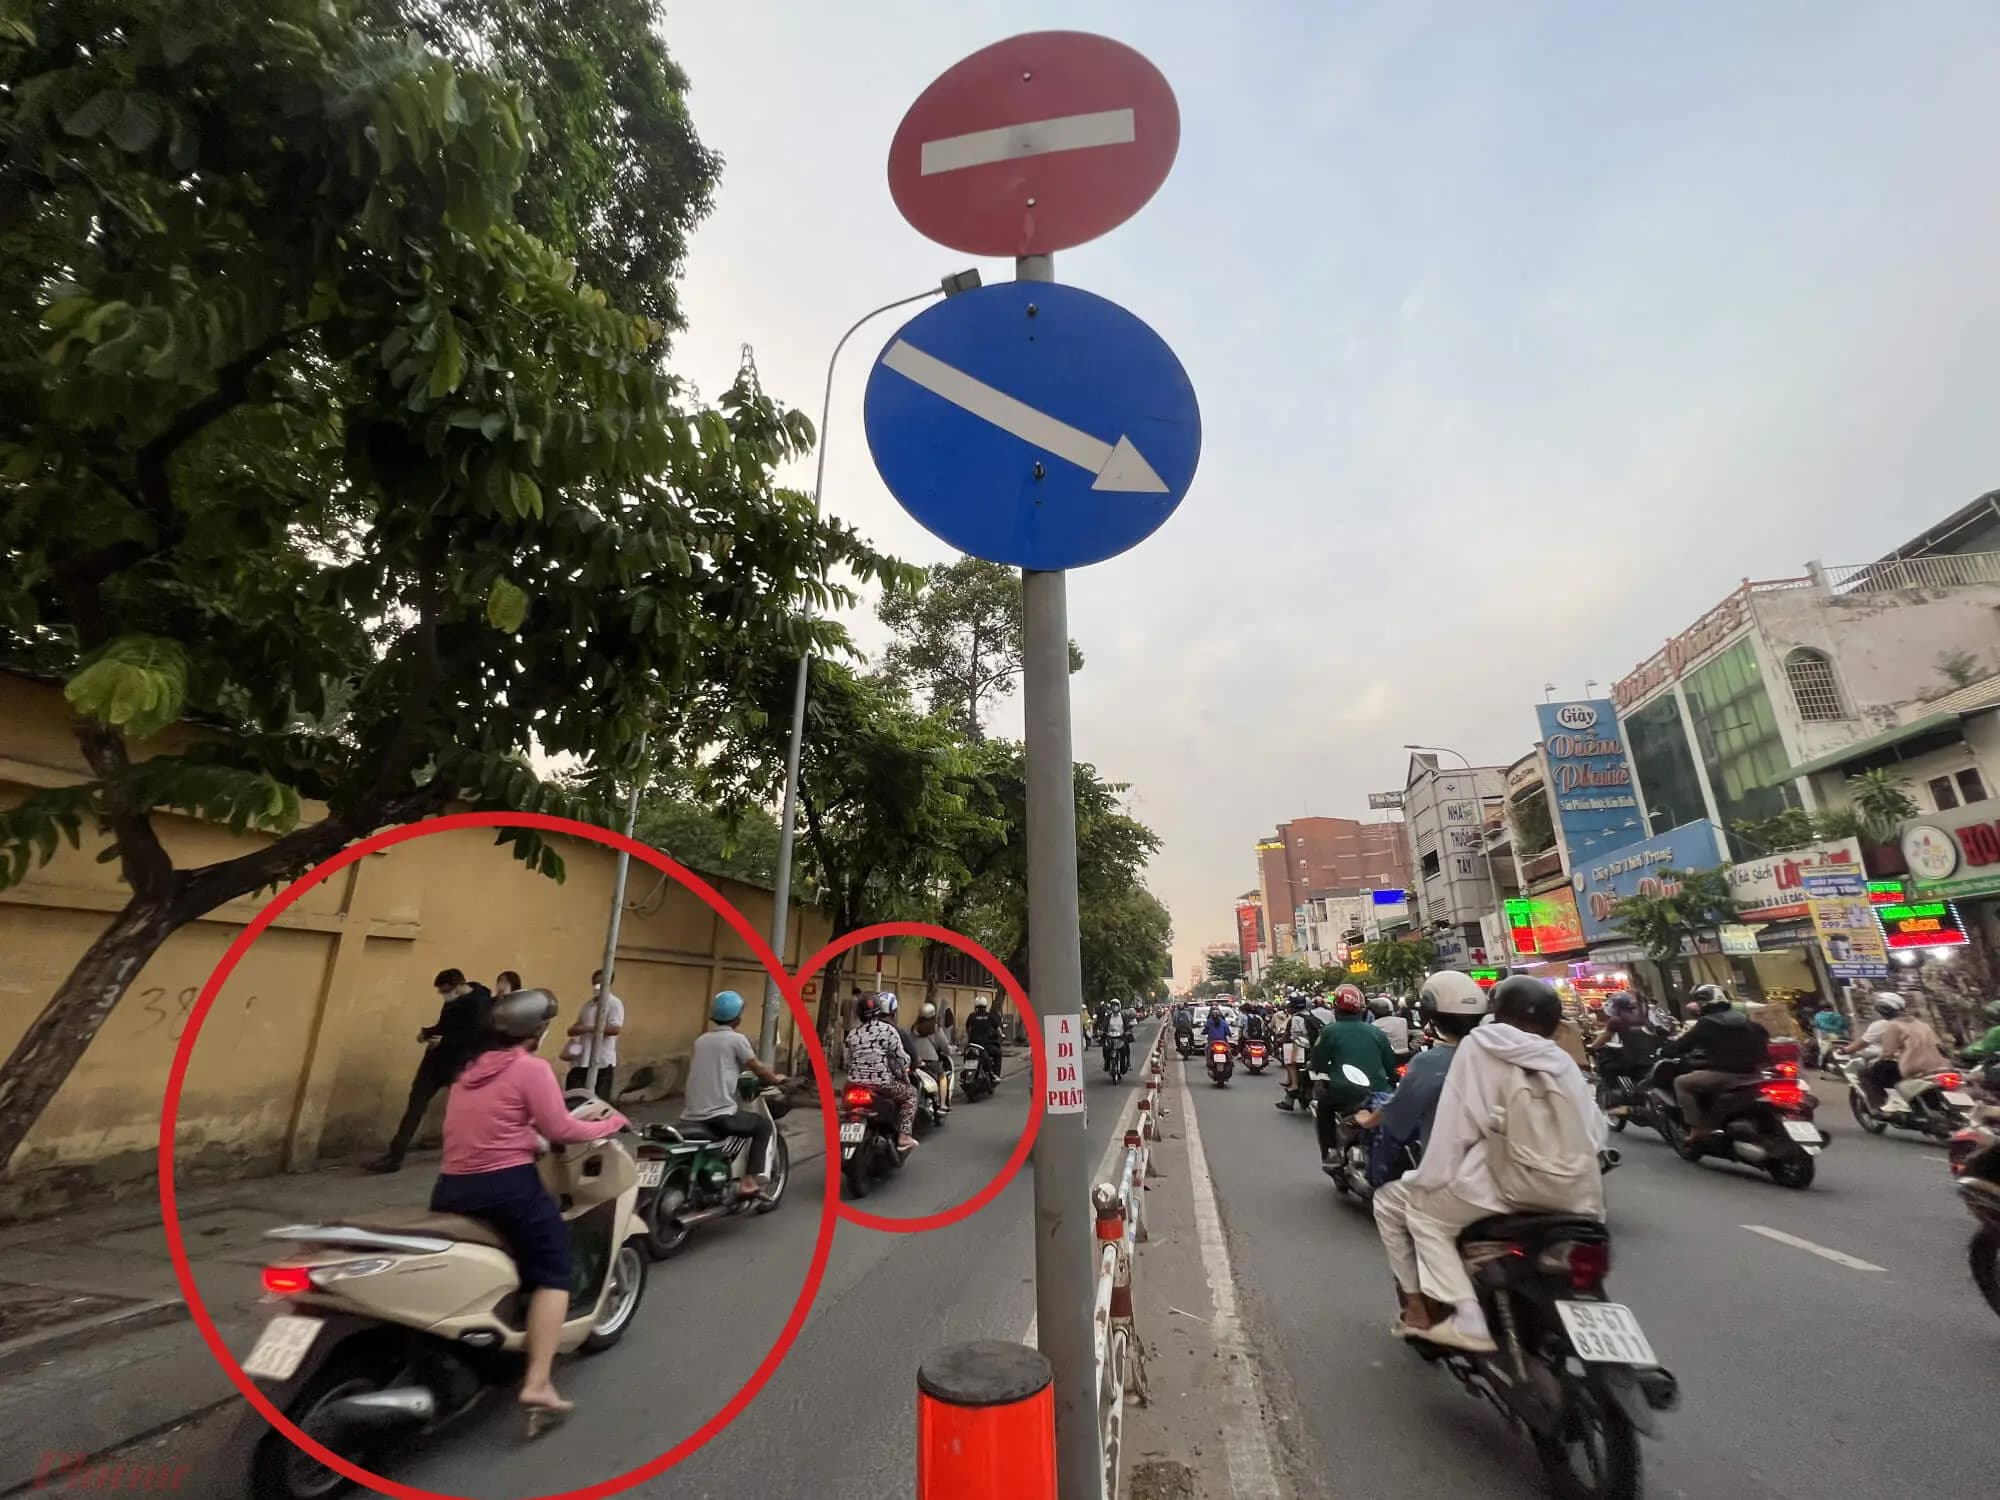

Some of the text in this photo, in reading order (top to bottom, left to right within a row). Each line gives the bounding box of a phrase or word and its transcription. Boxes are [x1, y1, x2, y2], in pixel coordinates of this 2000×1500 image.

[1560, 706, 1595, 725] Giày
[1061, 1019, 1069, 1033] A
[1058, 1043, 1073, 1057] DI
[1048, 1087, 1083, 1107] PHẬT
